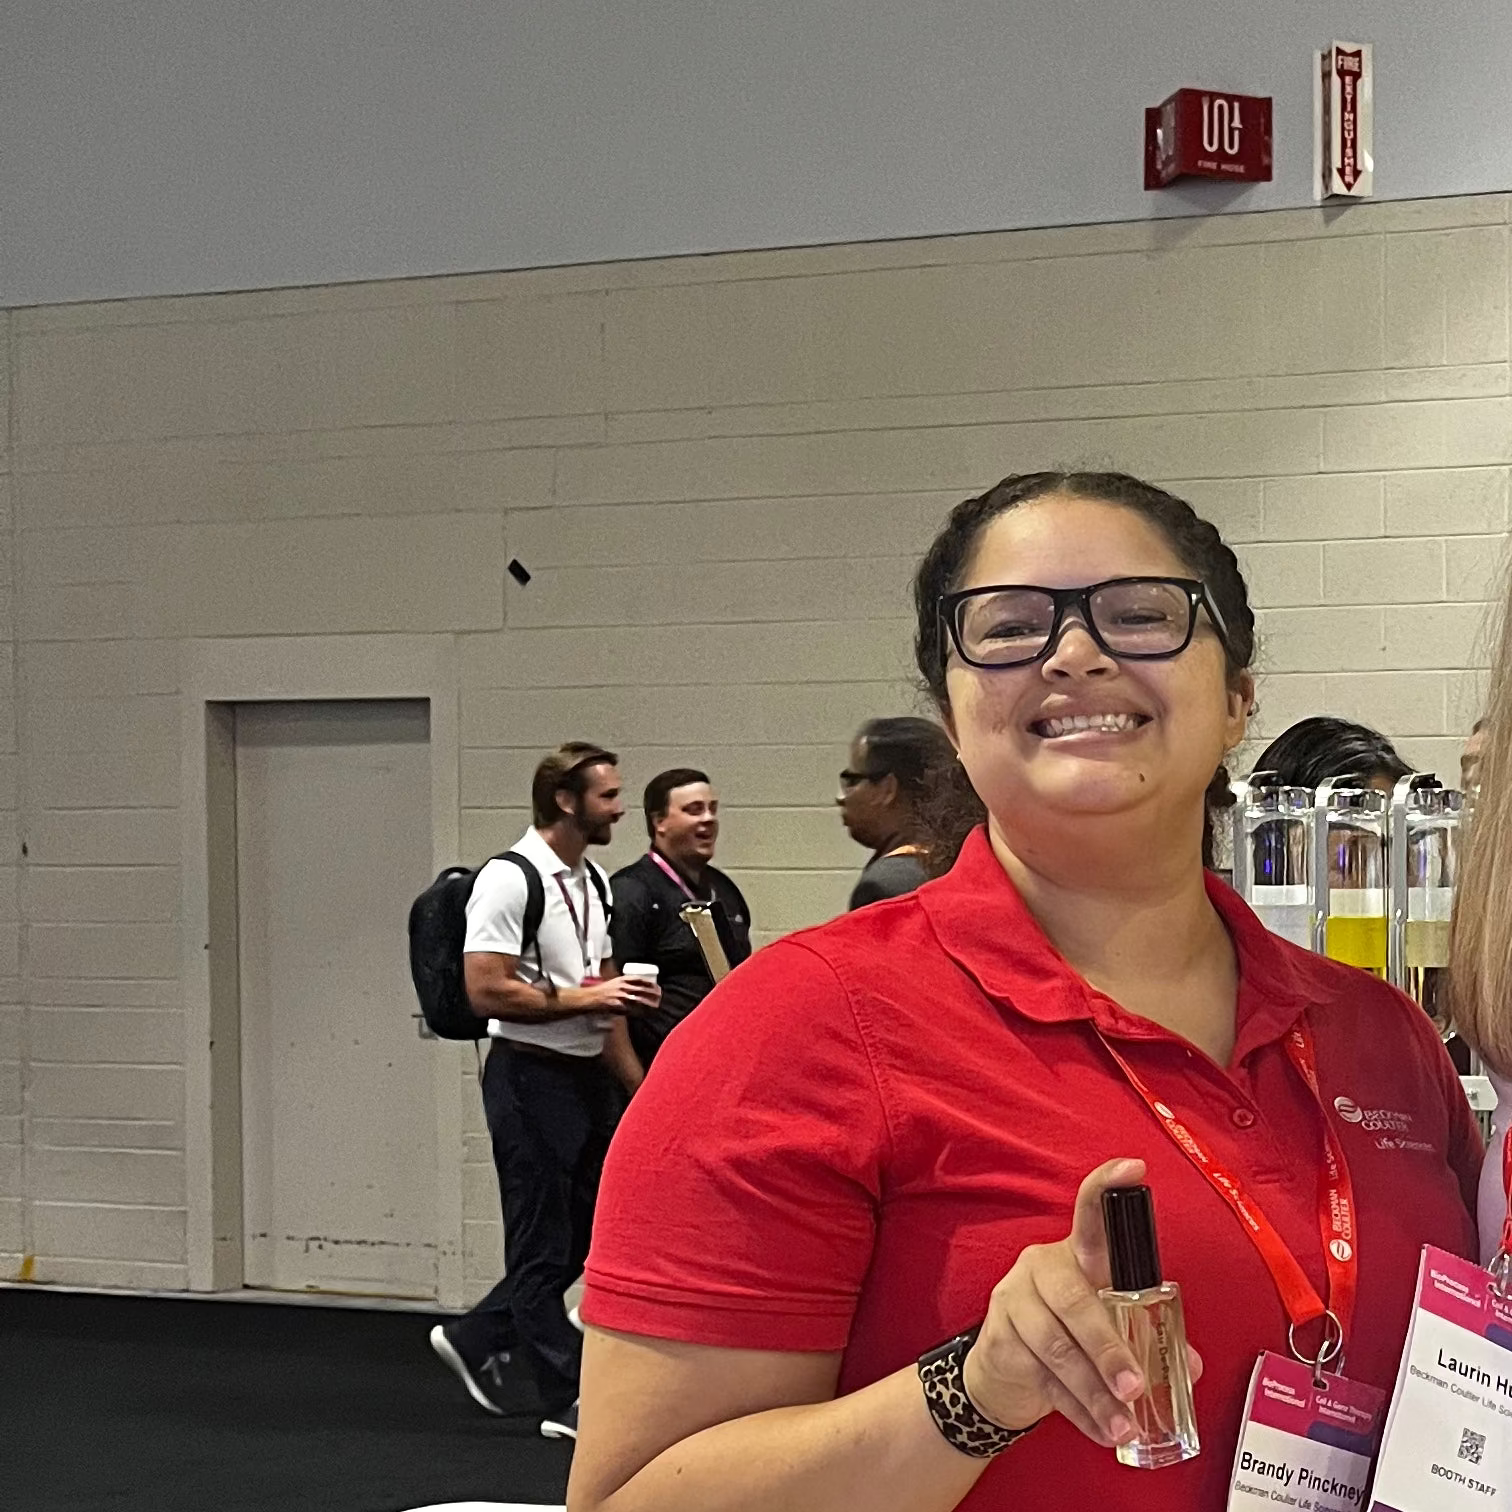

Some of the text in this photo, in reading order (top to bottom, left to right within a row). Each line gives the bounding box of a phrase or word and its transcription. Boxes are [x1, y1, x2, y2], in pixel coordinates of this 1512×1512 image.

[1337, 55, 1360, 72] FIRE
[1344, 75, 1354, 184] EXTINGUISHER
[1409, 1364, 1449, 1389] Beckman
[1450, 1383, 1480, 1402] Coulter
[1481, 1396, 1497, 1411] Life
[1437, 1347, 1491, 1388] Laurin
[1240, 1451, 1366, 1507] Brandy Pinckney
[1430, 1463, 1497, 1497] BOOTH STAFF
